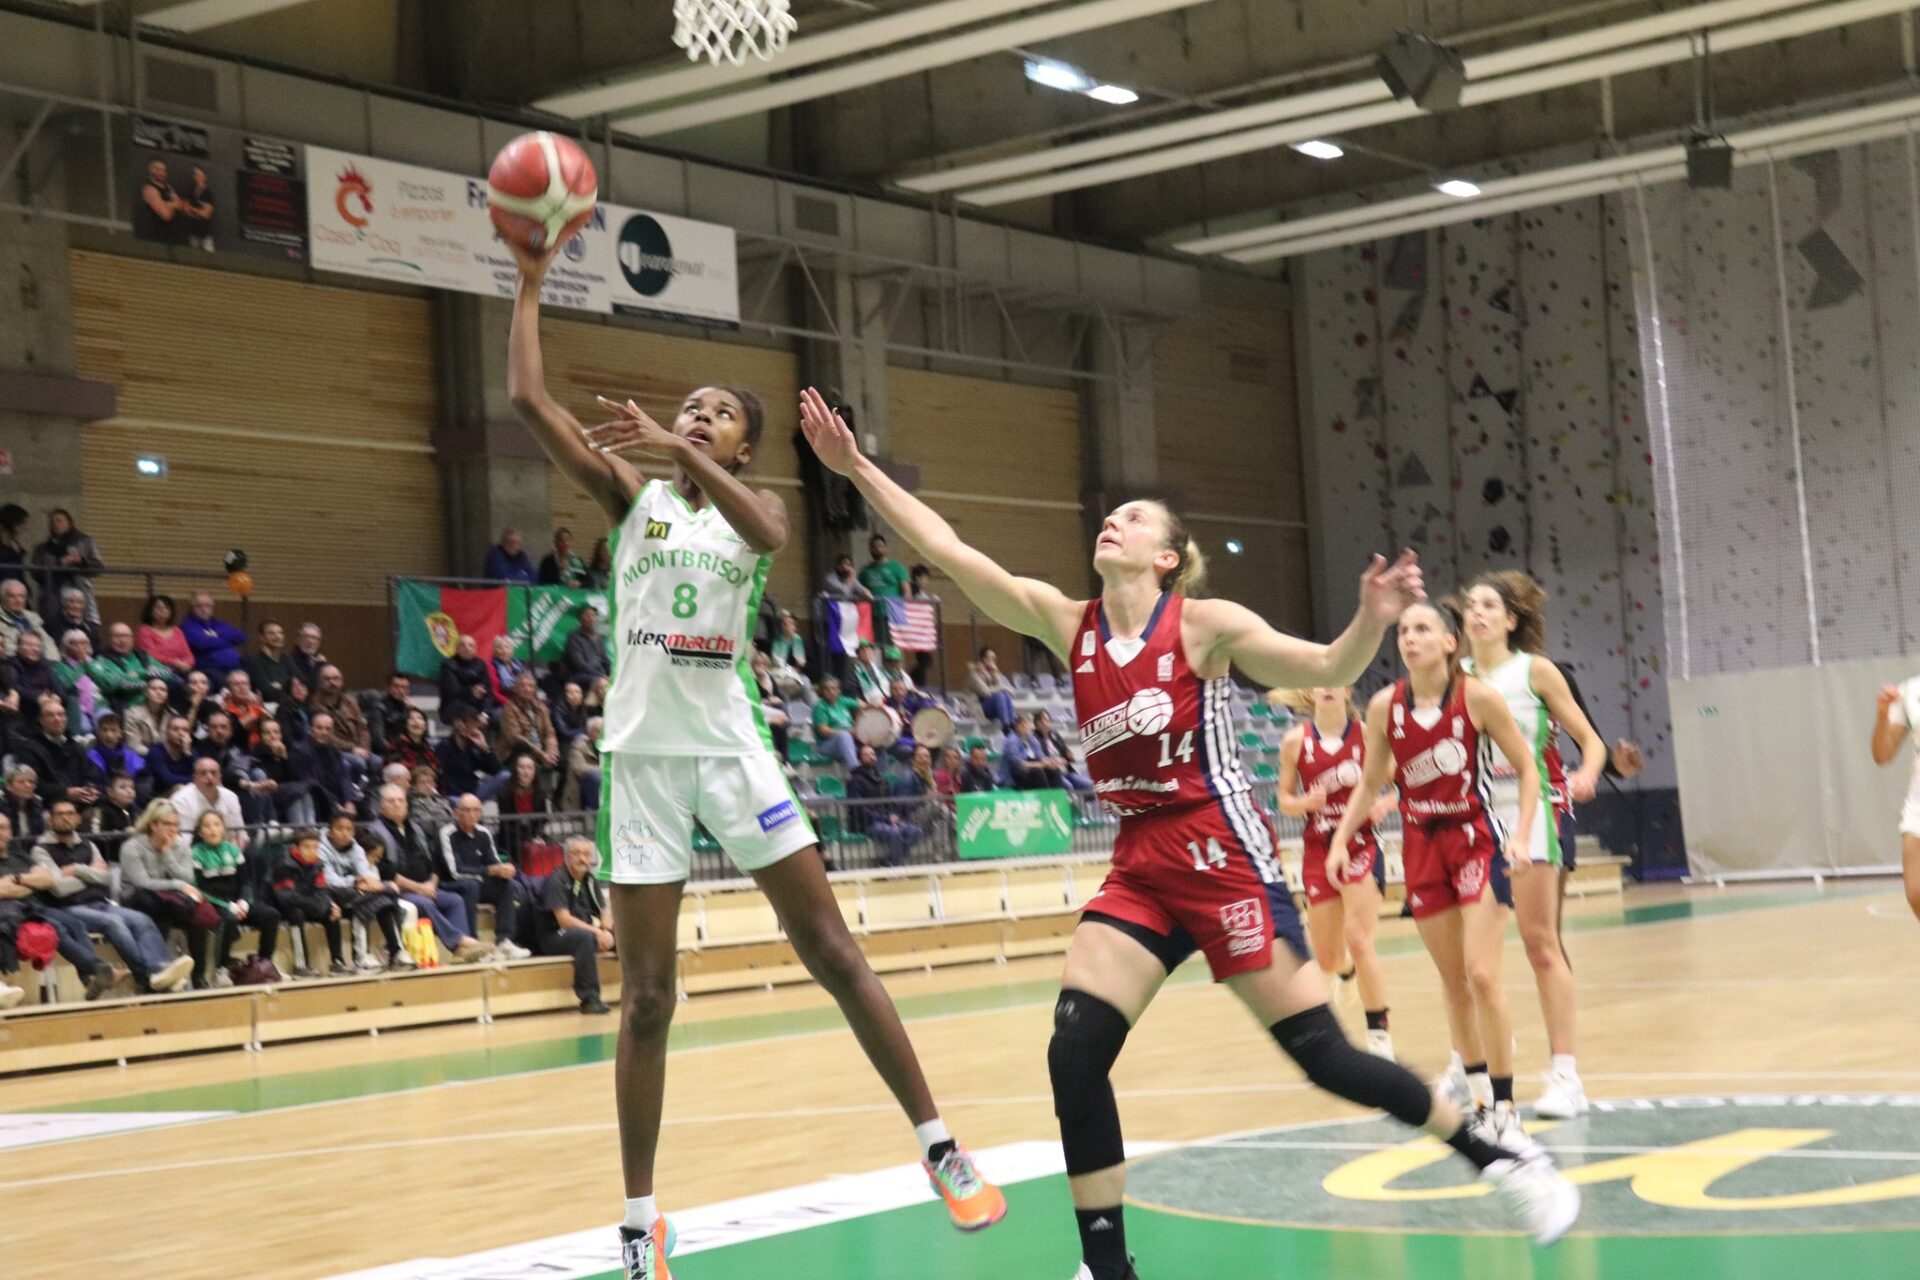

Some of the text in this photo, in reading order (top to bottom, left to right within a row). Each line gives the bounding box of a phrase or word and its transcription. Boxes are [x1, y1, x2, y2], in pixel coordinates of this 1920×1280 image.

[671, 582, 698, 619] 8
[1157, 730, 1194, 768] 14
[1187, 837, 1227, 871] 14
